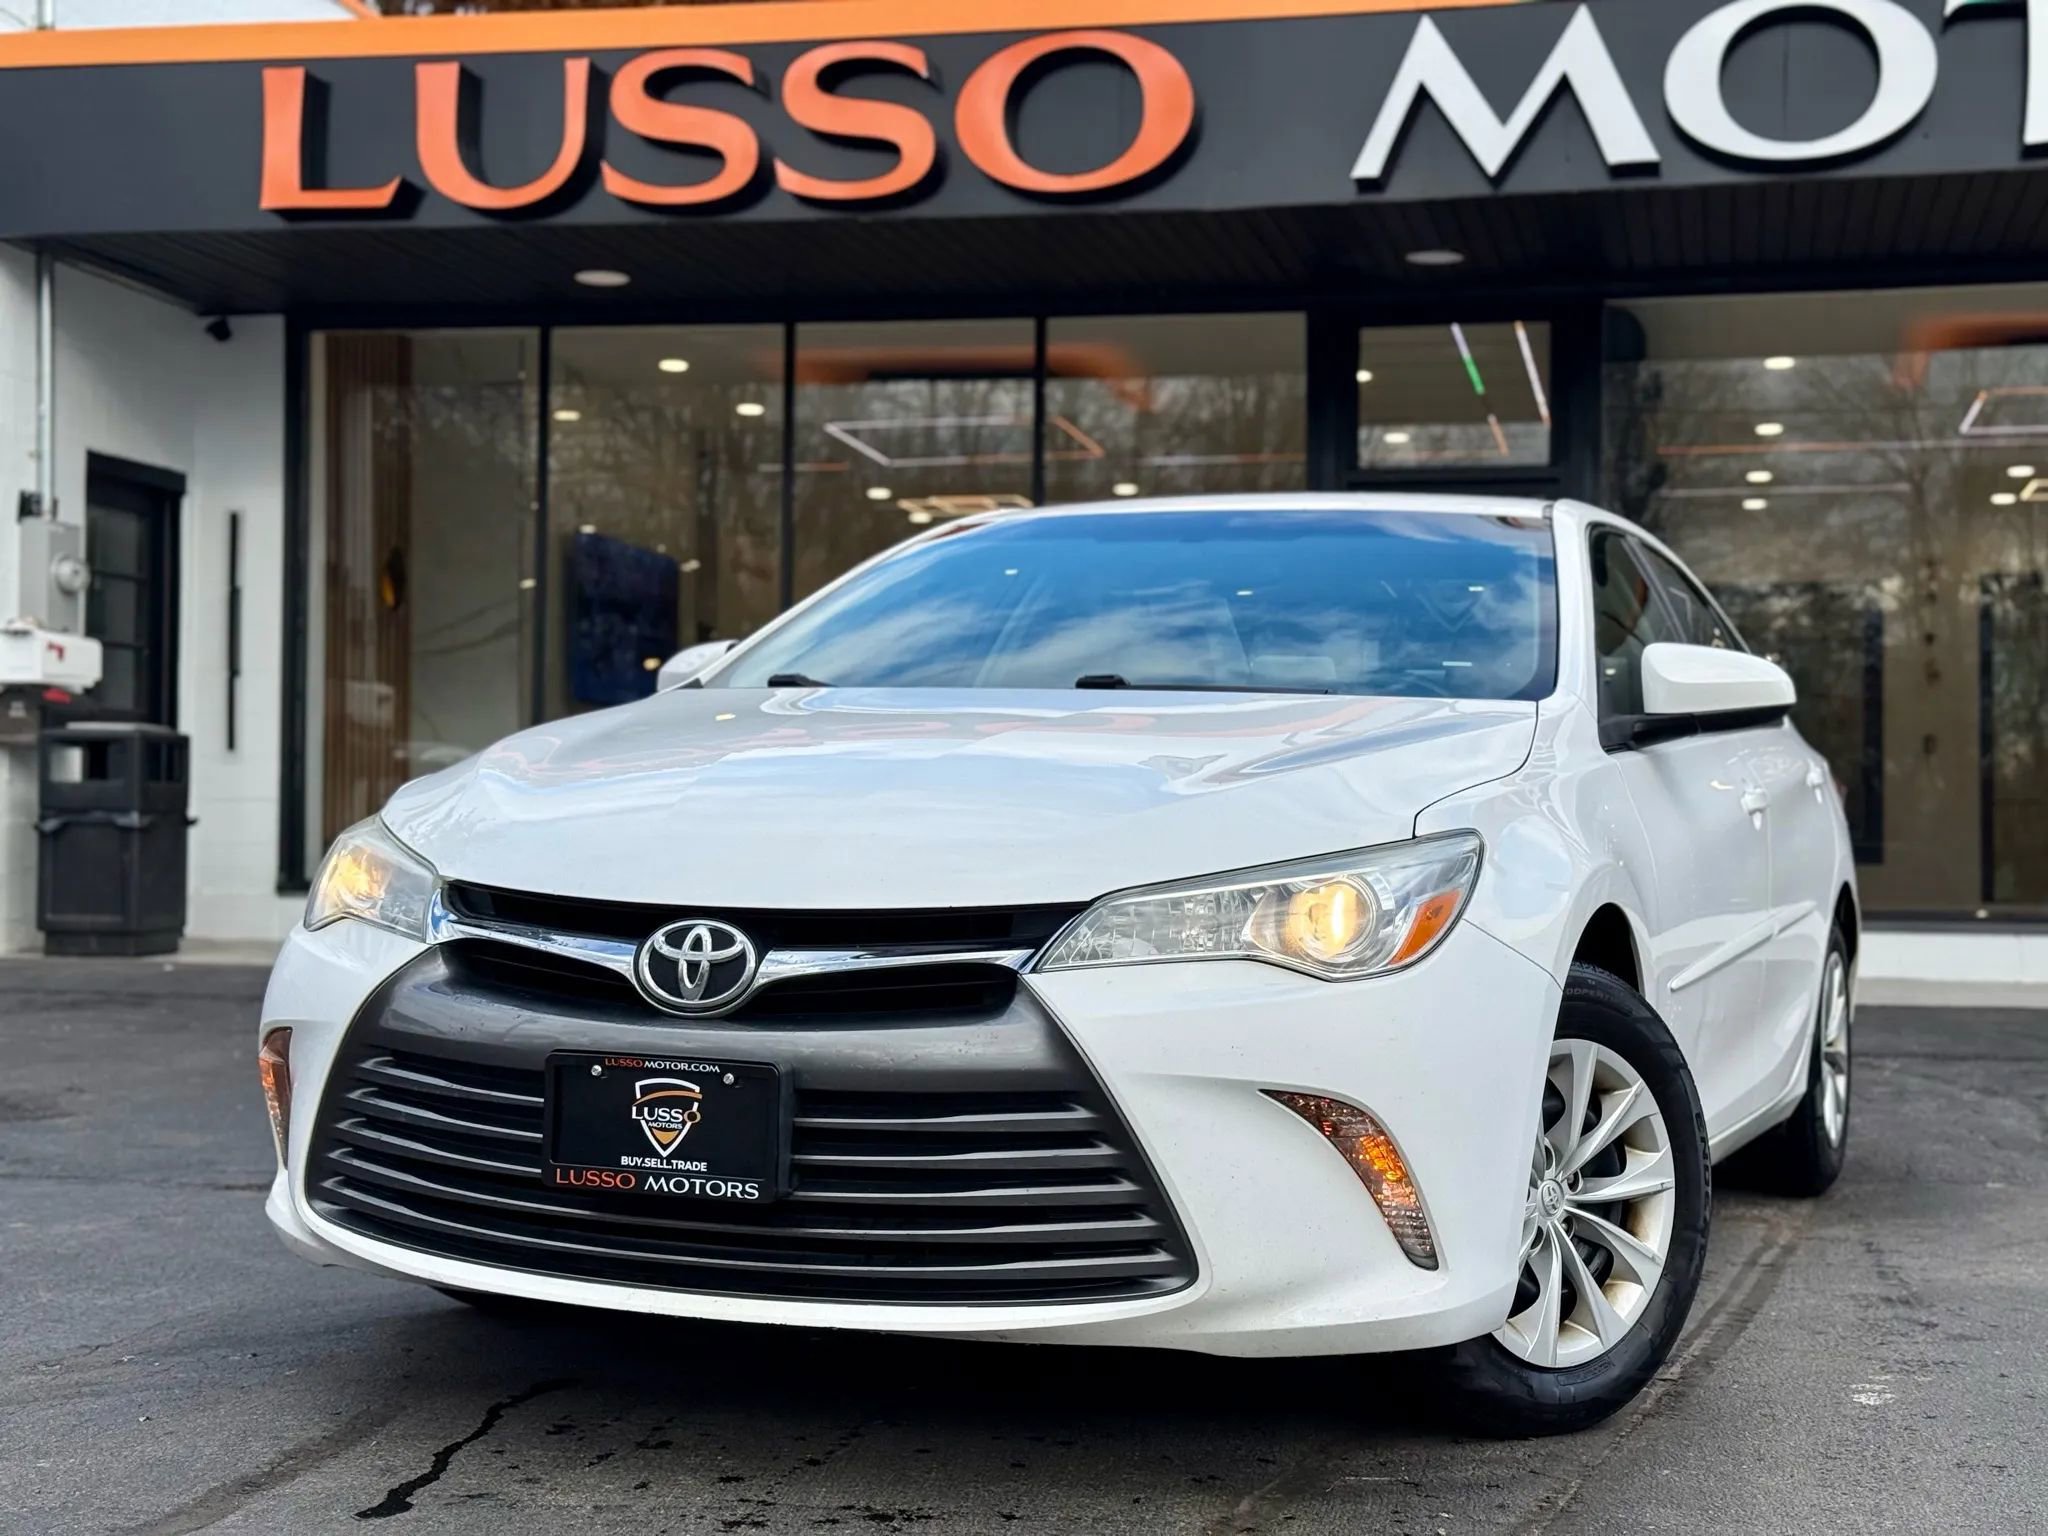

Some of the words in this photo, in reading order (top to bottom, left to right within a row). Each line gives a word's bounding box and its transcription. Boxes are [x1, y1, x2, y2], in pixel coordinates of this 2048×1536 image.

[259, 29, 1196, 211] LUSSO
[605, 1058, 721, 1073] LUSSOMOTOR.COM
[631, 1105, 701, 1124] LUSSO
[647, 1121, 683, 1130] MOTORS
[620, 1155, 708, 1172] BUY.SELL.TRADE
[556, 1167, 636, 1190] LUSSO
[643, 1174, 760, 1200] MOTORS
